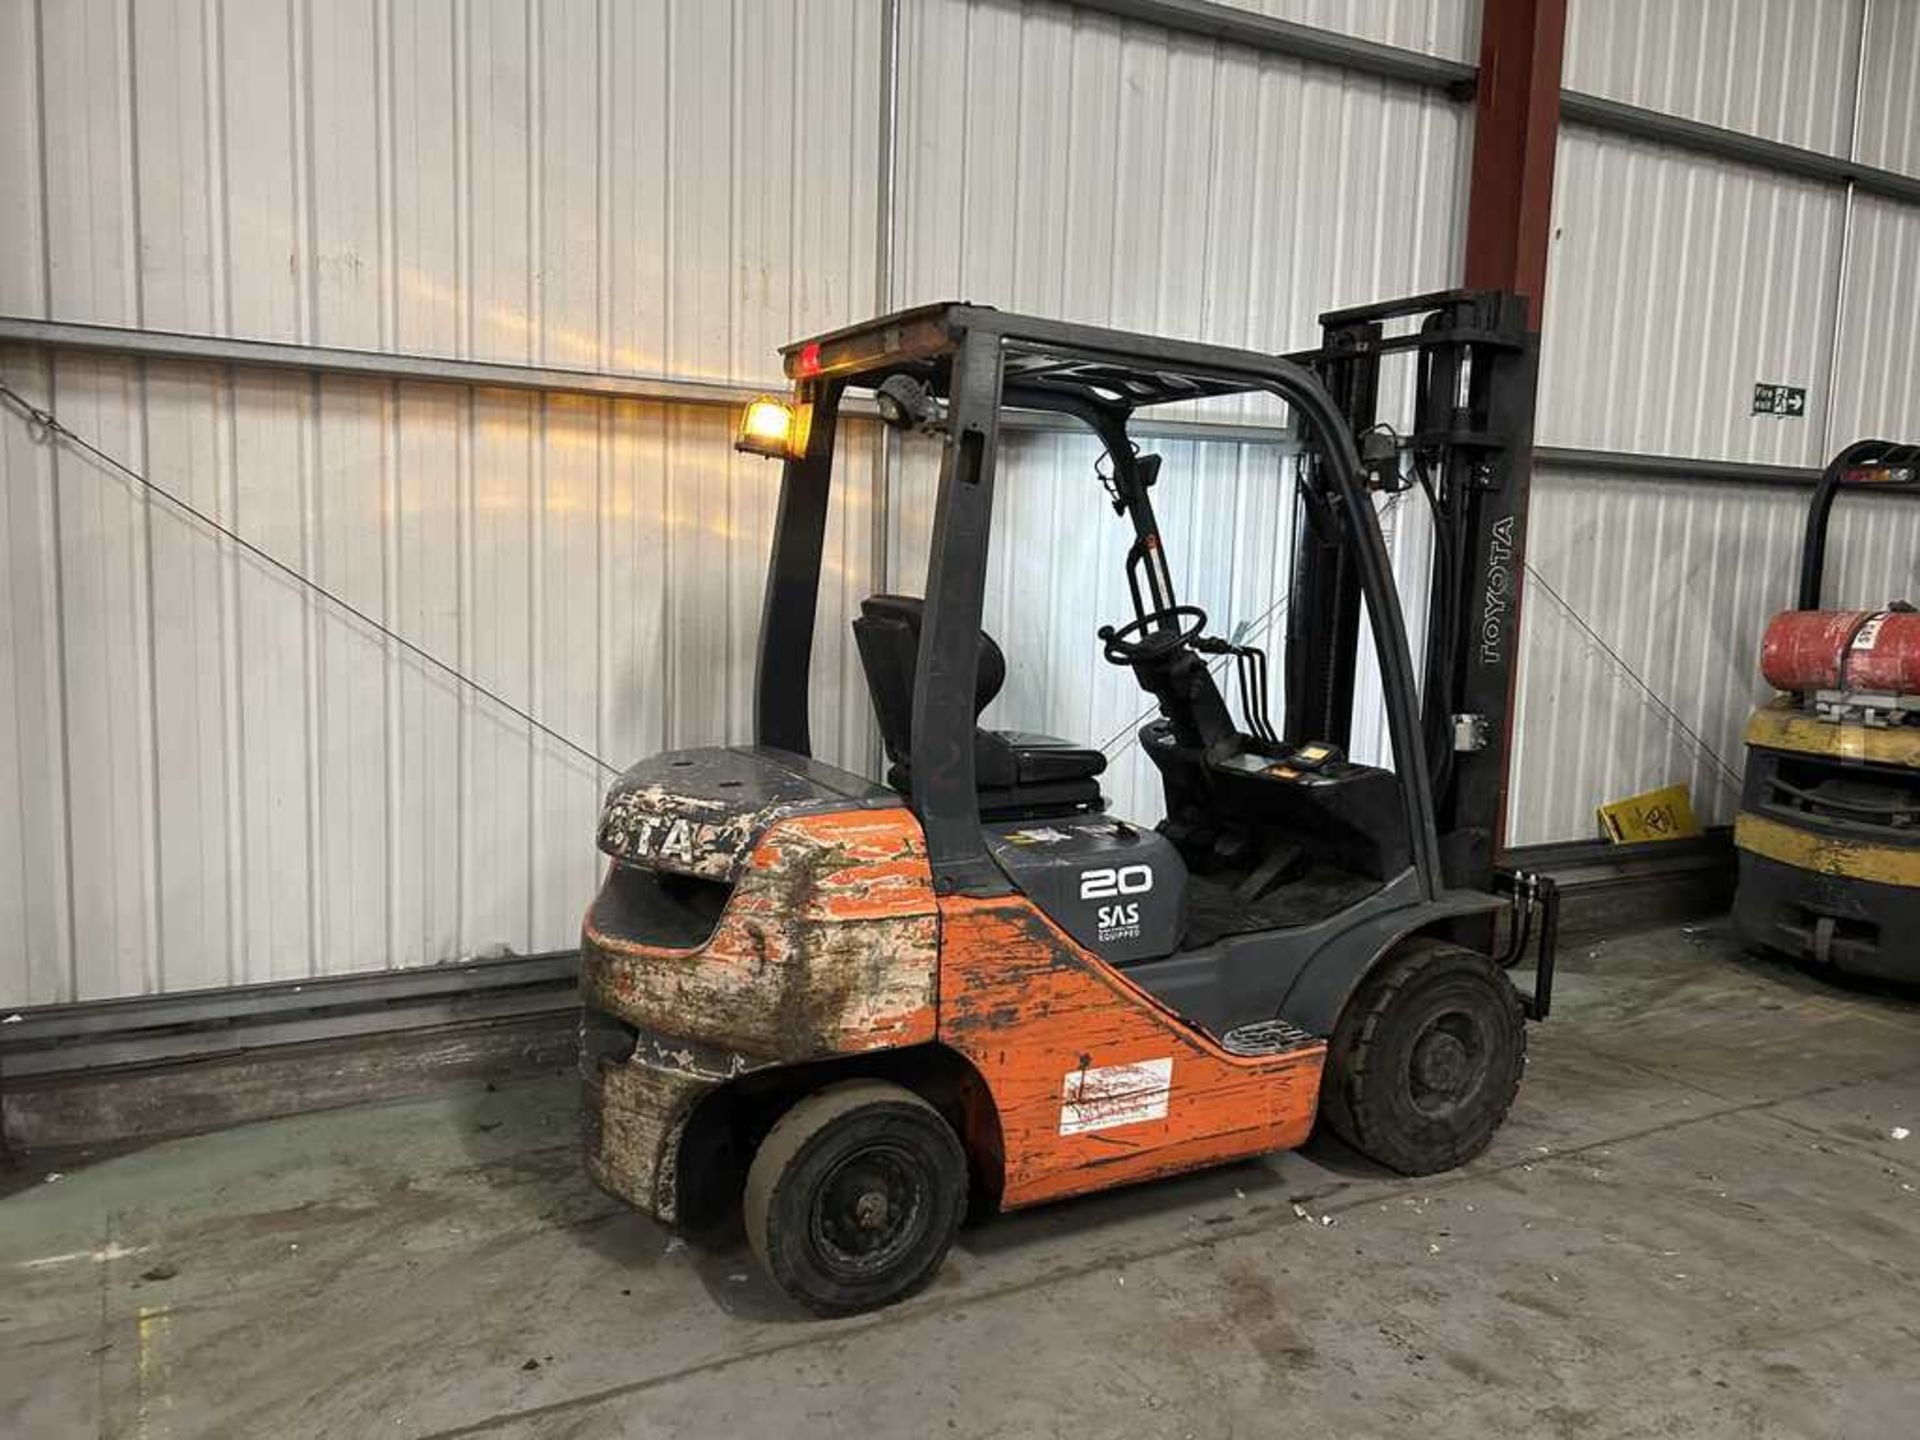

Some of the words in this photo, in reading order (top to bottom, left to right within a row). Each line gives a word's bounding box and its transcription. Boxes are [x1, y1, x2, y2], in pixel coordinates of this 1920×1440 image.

[1480, 516, 1514, 664] TOYOTA
[1081, 864, 1153, 899] 20
[1098, 903, 1139, 928] SAS
